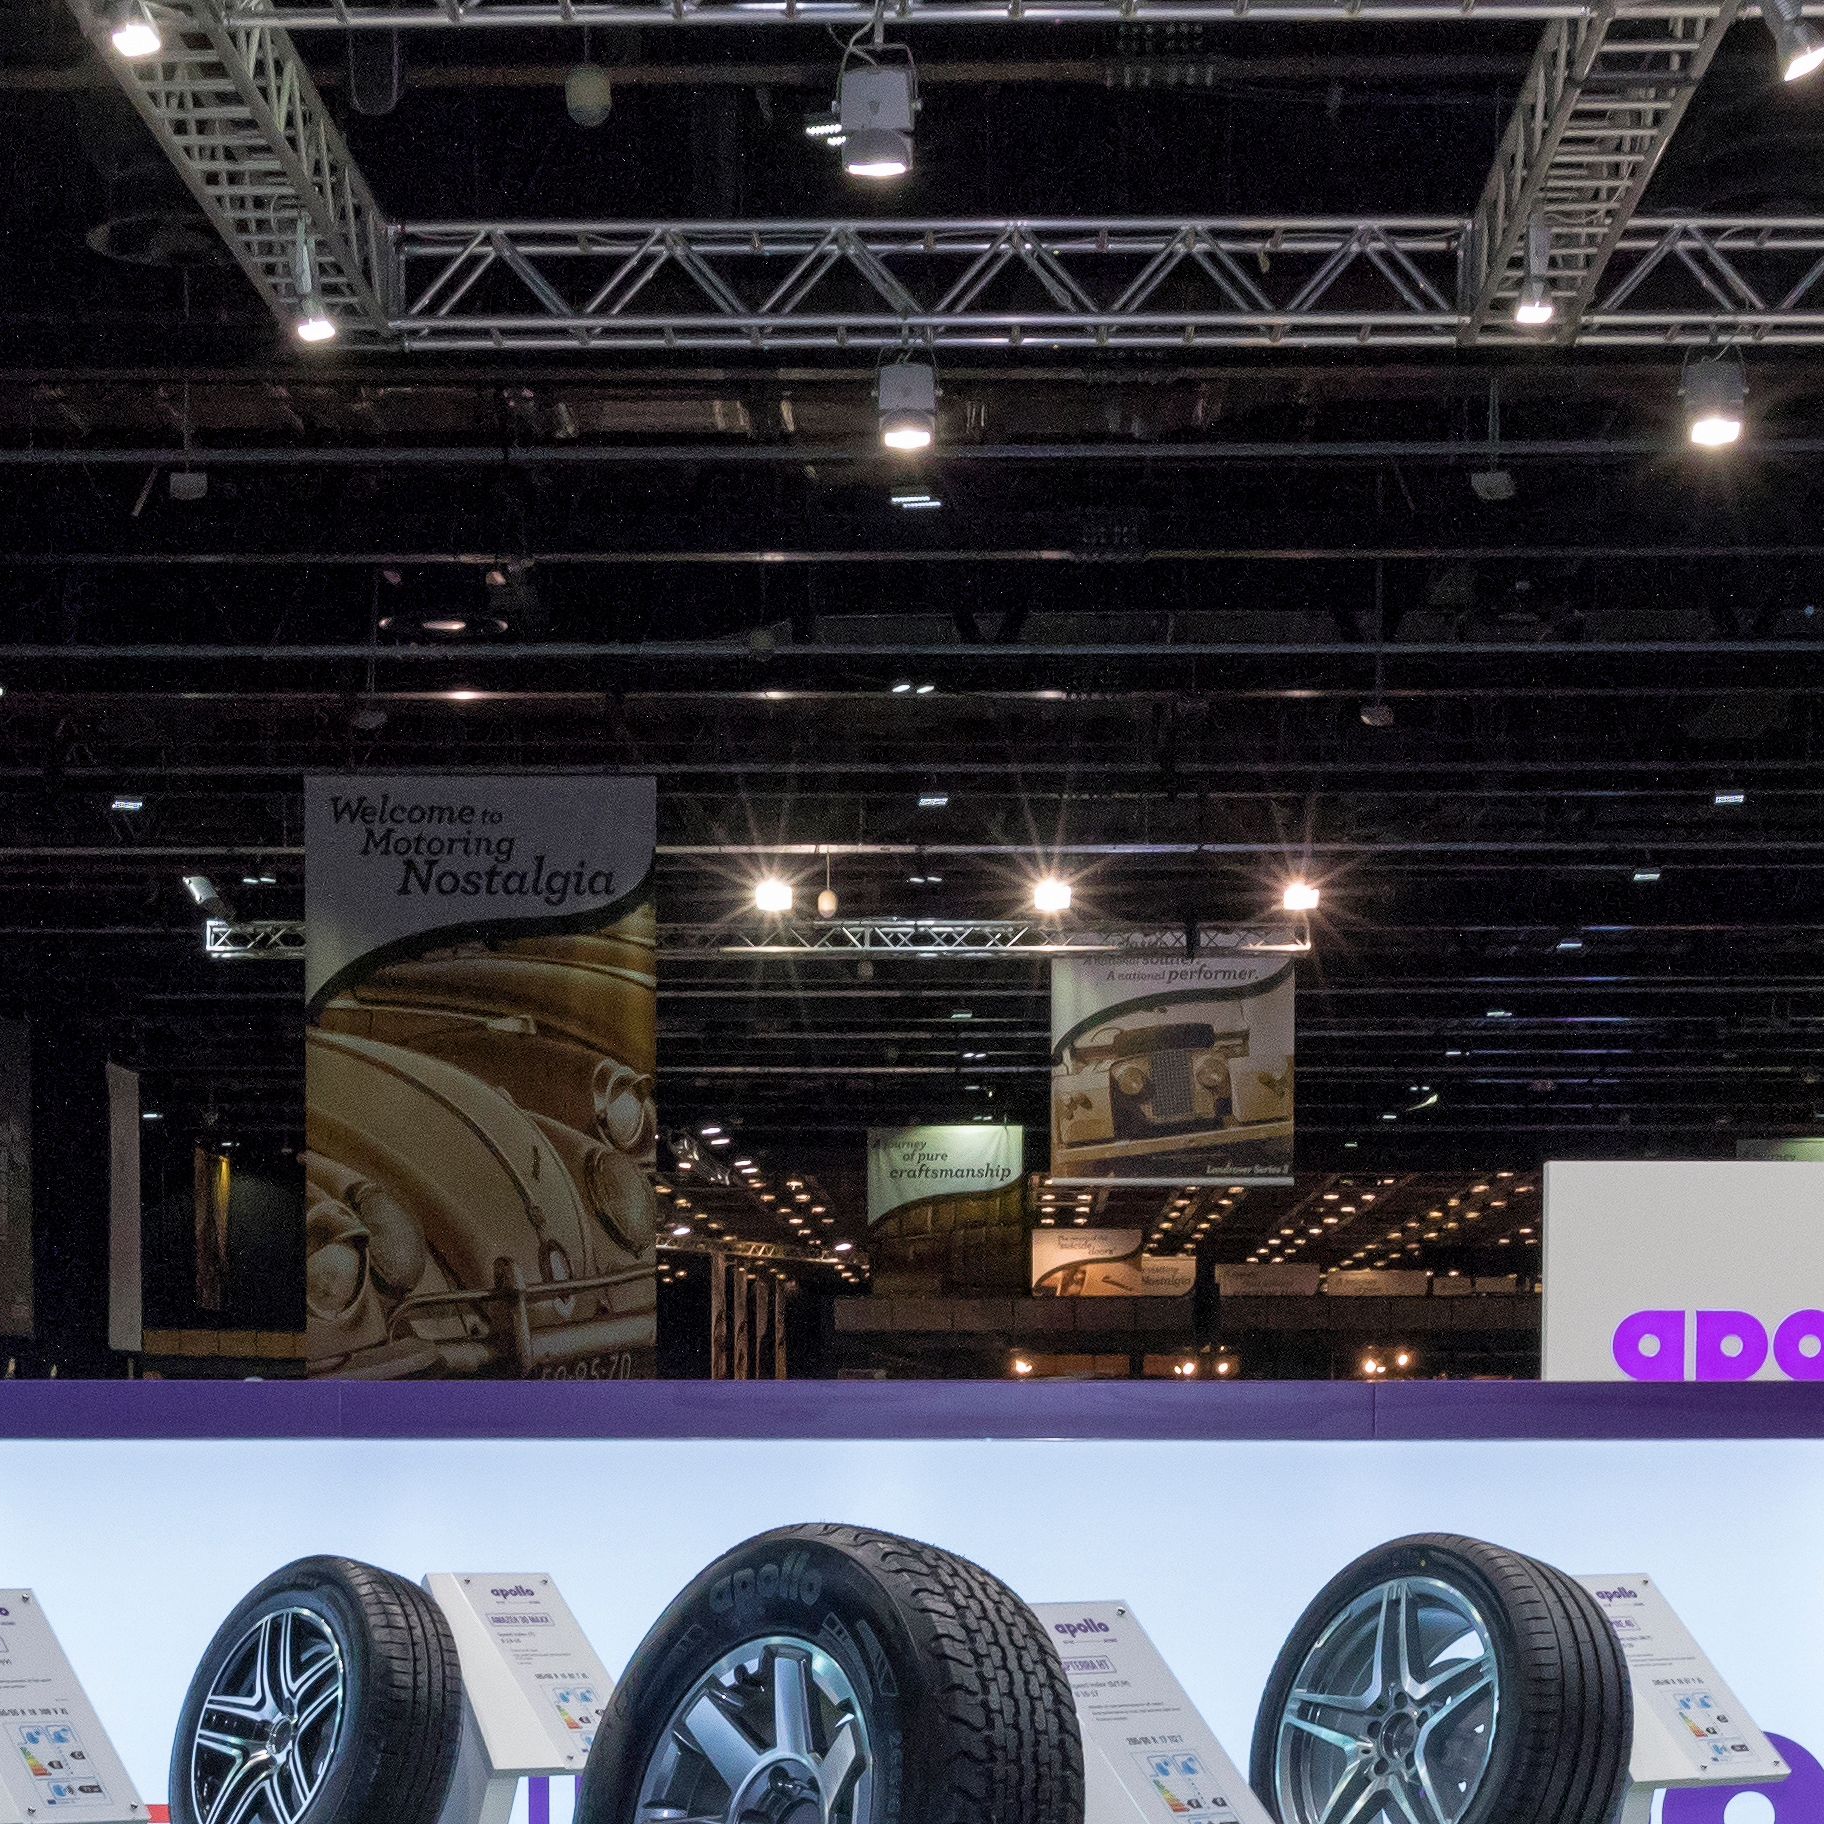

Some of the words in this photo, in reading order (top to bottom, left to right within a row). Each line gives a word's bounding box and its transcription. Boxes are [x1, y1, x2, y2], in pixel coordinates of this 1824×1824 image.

[329, 794, 476, 826] Welcome
[481, 807, 504, 826] to
[360, 827, 516, 864] Motoring
[396, 854, 616, 907] Nostalgia
[1166, 963, 1260, 985] performer.
[902, 1148, 916, 1162] of
[916, 1151, 949, 1164] pure
[889, 1161, 1012, 1182] craftsmanship
[490, 1585, 535, 1600] apollo
[709, 1550, 824, 1616] apollo
[1595, 1586, 1638, 1602] apollo
[1054, 1617, 1110, 1639] apollo
